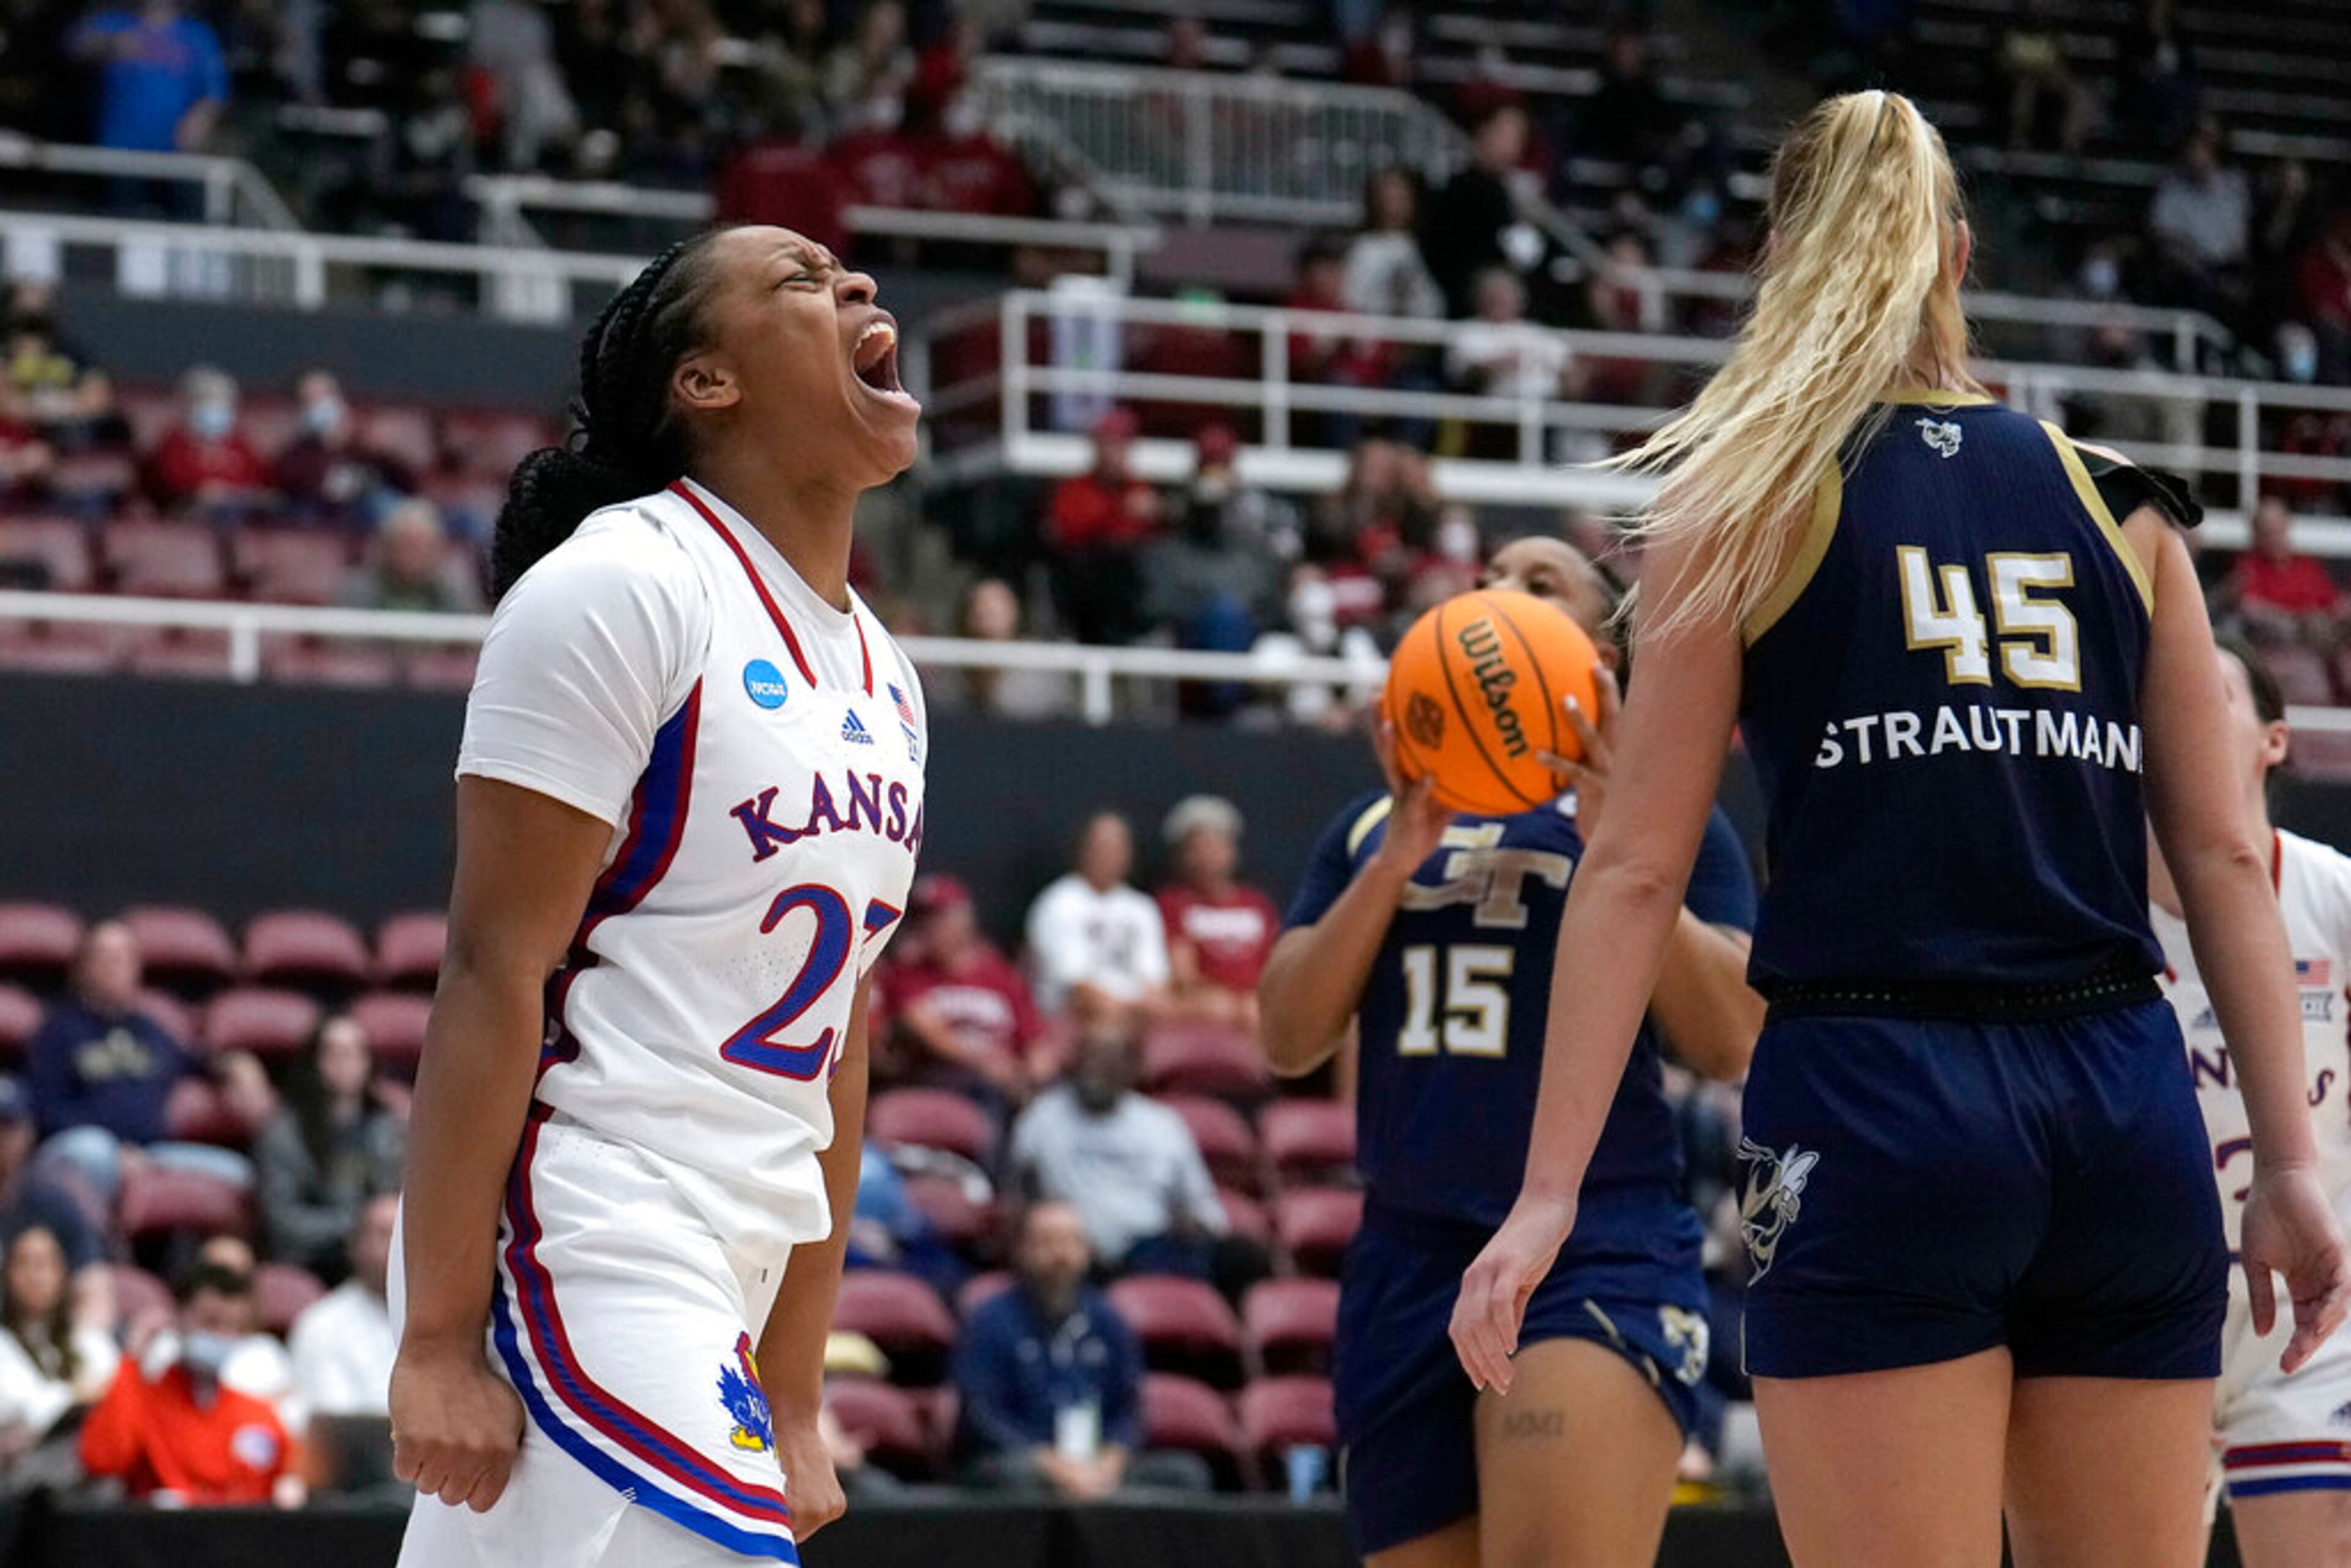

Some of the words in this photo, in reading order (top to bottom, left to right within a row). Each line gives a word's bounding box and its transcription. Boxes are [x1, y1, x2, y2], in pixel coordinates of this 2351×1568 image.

[1896, 544, 2082, 692] 45
[749, 680, 787, 696] NCAA
[841, 731, 874, 745] adidas
[1458, 618, 1531, 760] Wilson
[1815, 705, 2142, 773] STRAUTMAN
[719, 883, 902, 1082] 2
[1398, 945, 1515, 1059] 15
